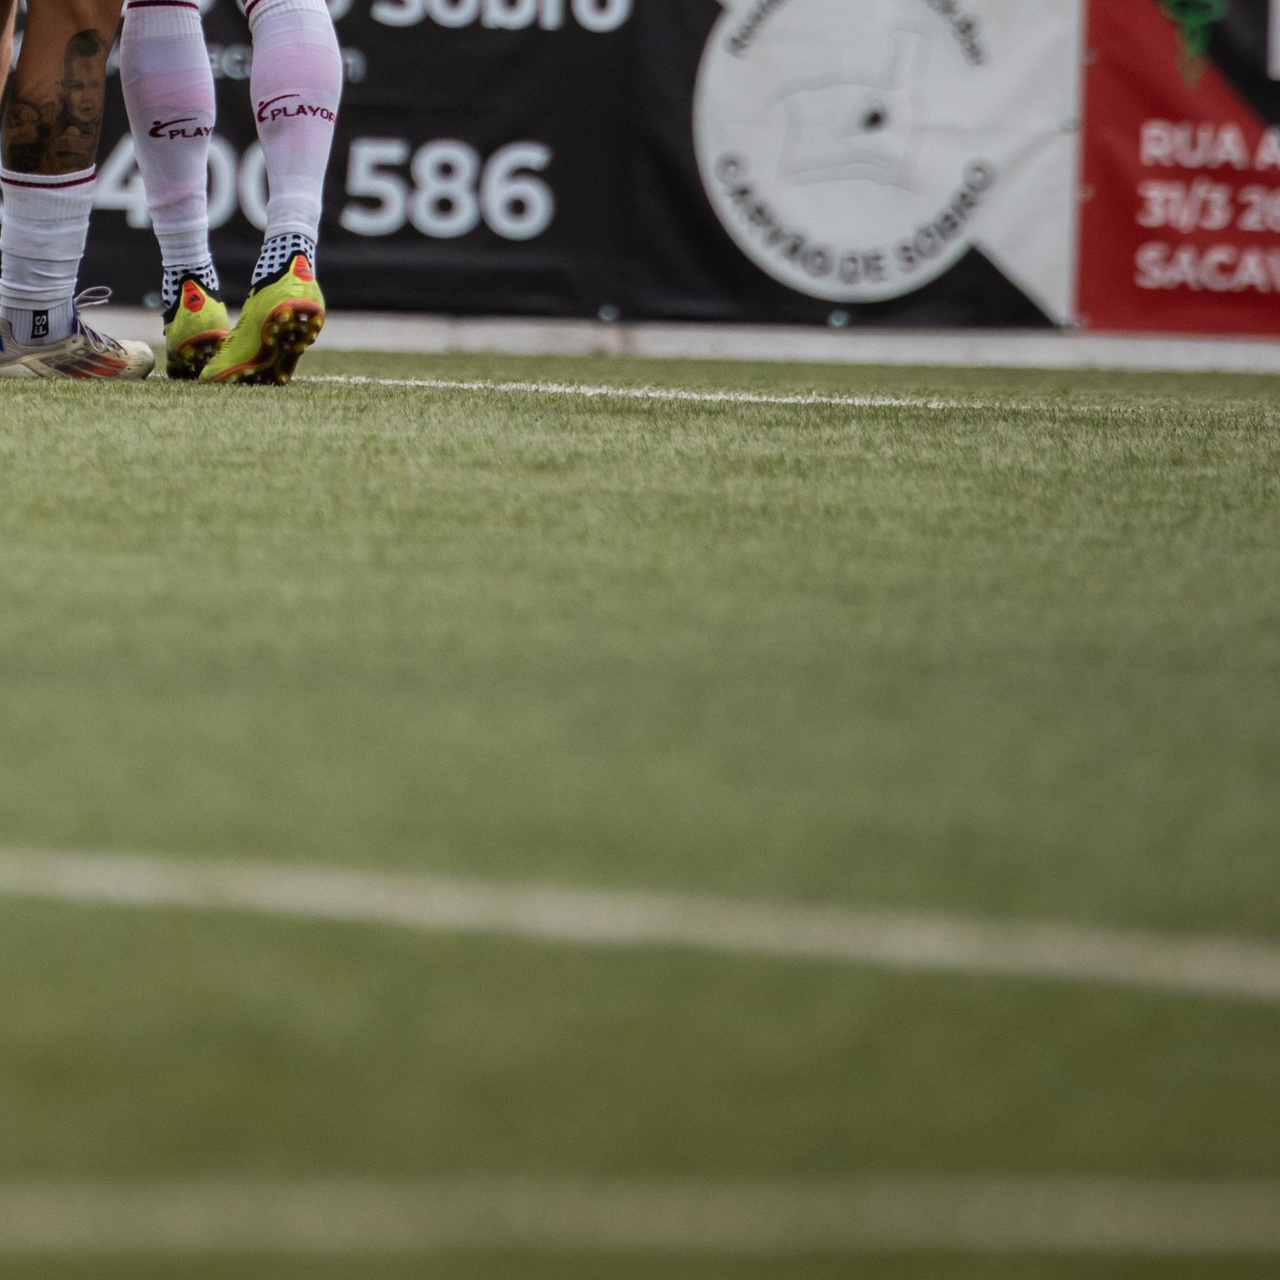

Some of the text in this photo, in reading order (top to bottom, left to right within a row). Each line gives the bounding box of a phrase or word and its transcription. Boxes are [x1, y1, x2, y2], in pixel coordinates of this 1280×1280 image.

[169, 126, 214, 139] PLAY
[1139, 119, 1250, 170] RUA
[340, 139, 557, 241] 586
